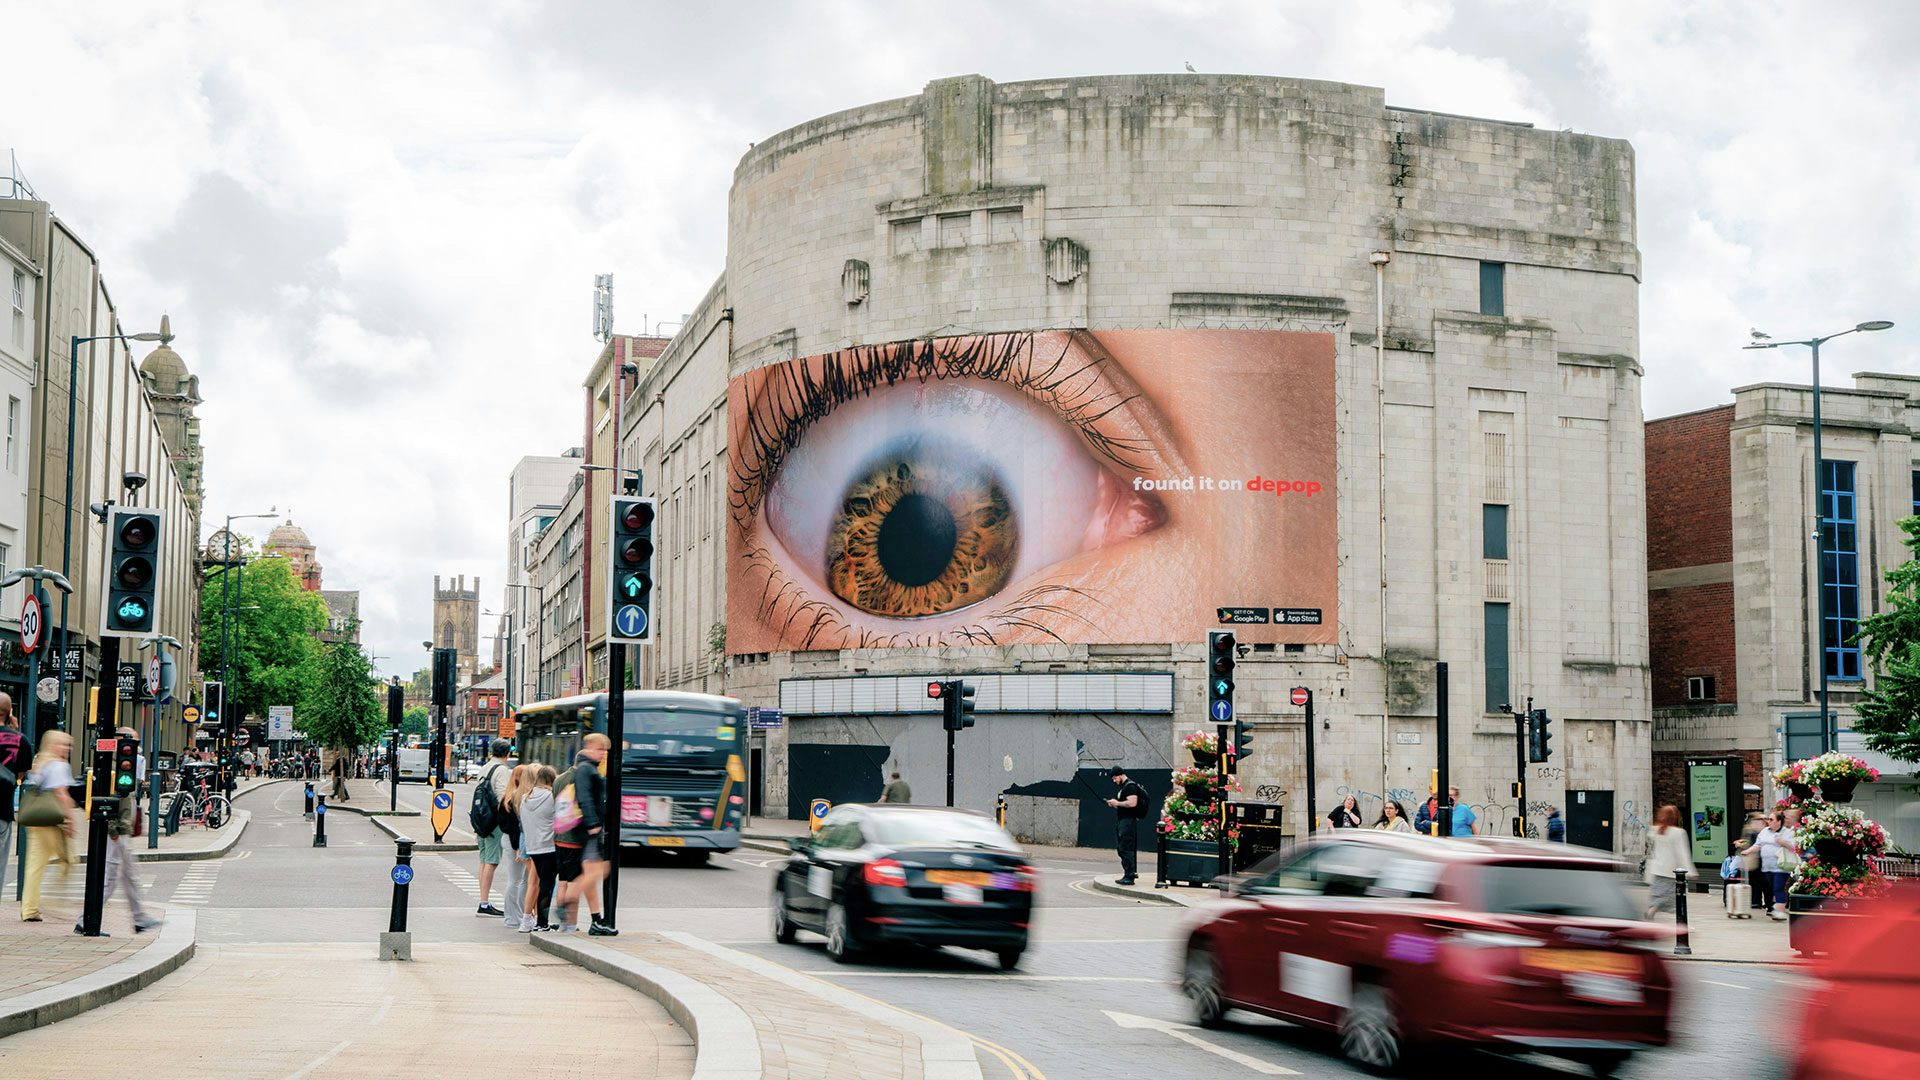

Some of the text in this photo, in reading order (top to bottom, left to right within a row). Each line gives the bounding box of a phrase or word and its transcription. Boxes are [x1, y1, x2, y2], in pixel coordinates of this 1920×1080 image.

[1133, 475, 1322, 497] found it on depop
[1233, 615, 1266, 623] Google Play
[1287, 615, 1300, 623] App
[23, 611, 38, 636] 30
[52, 650, 80, 659] LME
[117, 675, 135, 683] IME
